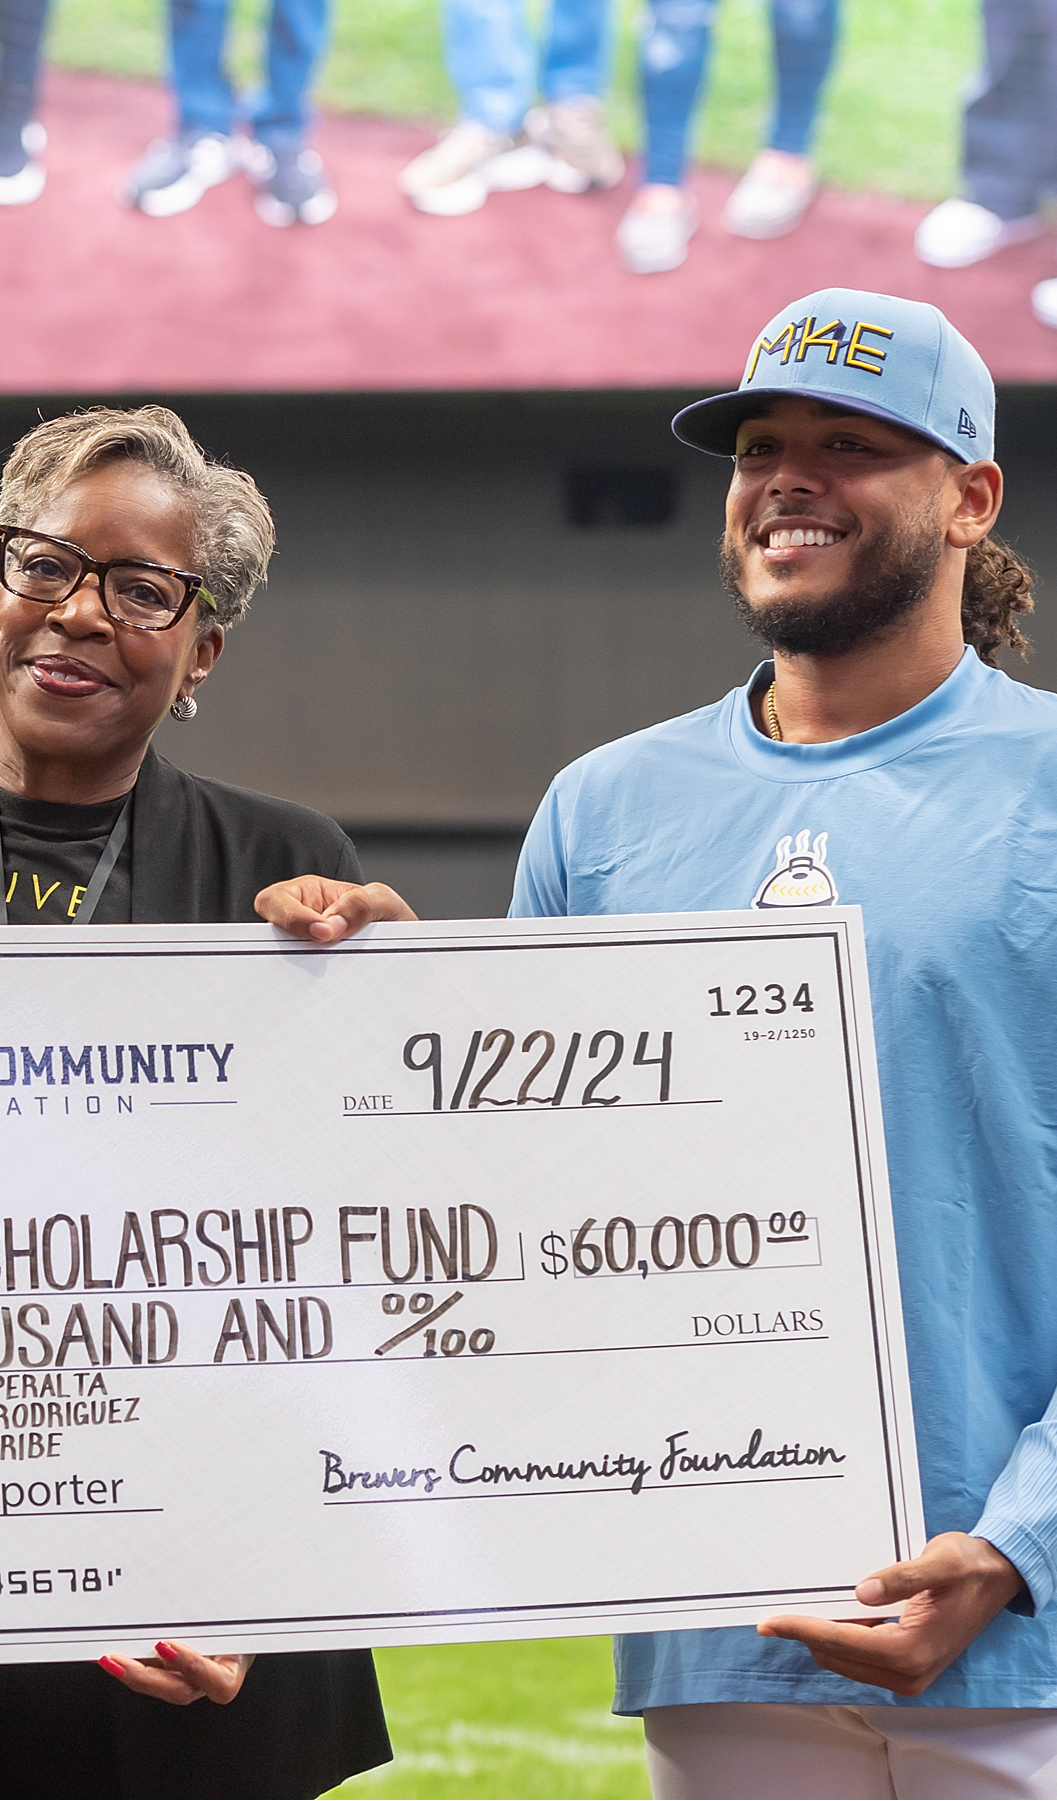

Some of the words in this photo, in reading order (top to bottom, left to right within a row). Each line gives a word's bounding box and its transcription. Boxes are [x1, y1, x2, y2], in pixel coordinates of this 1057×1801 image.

[747, 316, 894, 384] MKE
[707, 982, 816, 1018] 1234
[743, 1027, 816, 1042] 19-2/1250
[343, 1094, 394, 1112] DATE
[402, 1028, 673, 1111] 9/22/24
[339, 1203, 498, 1284] FUND
[214, 1295, 333, 1363] AND
[691, 1308, 824, 1338] DOLLARS
[319, 1449, 441, 1494] Brewers
[448, 1443, 652, 1495] Community
[659, 1428, 846, 1480] Foundation
